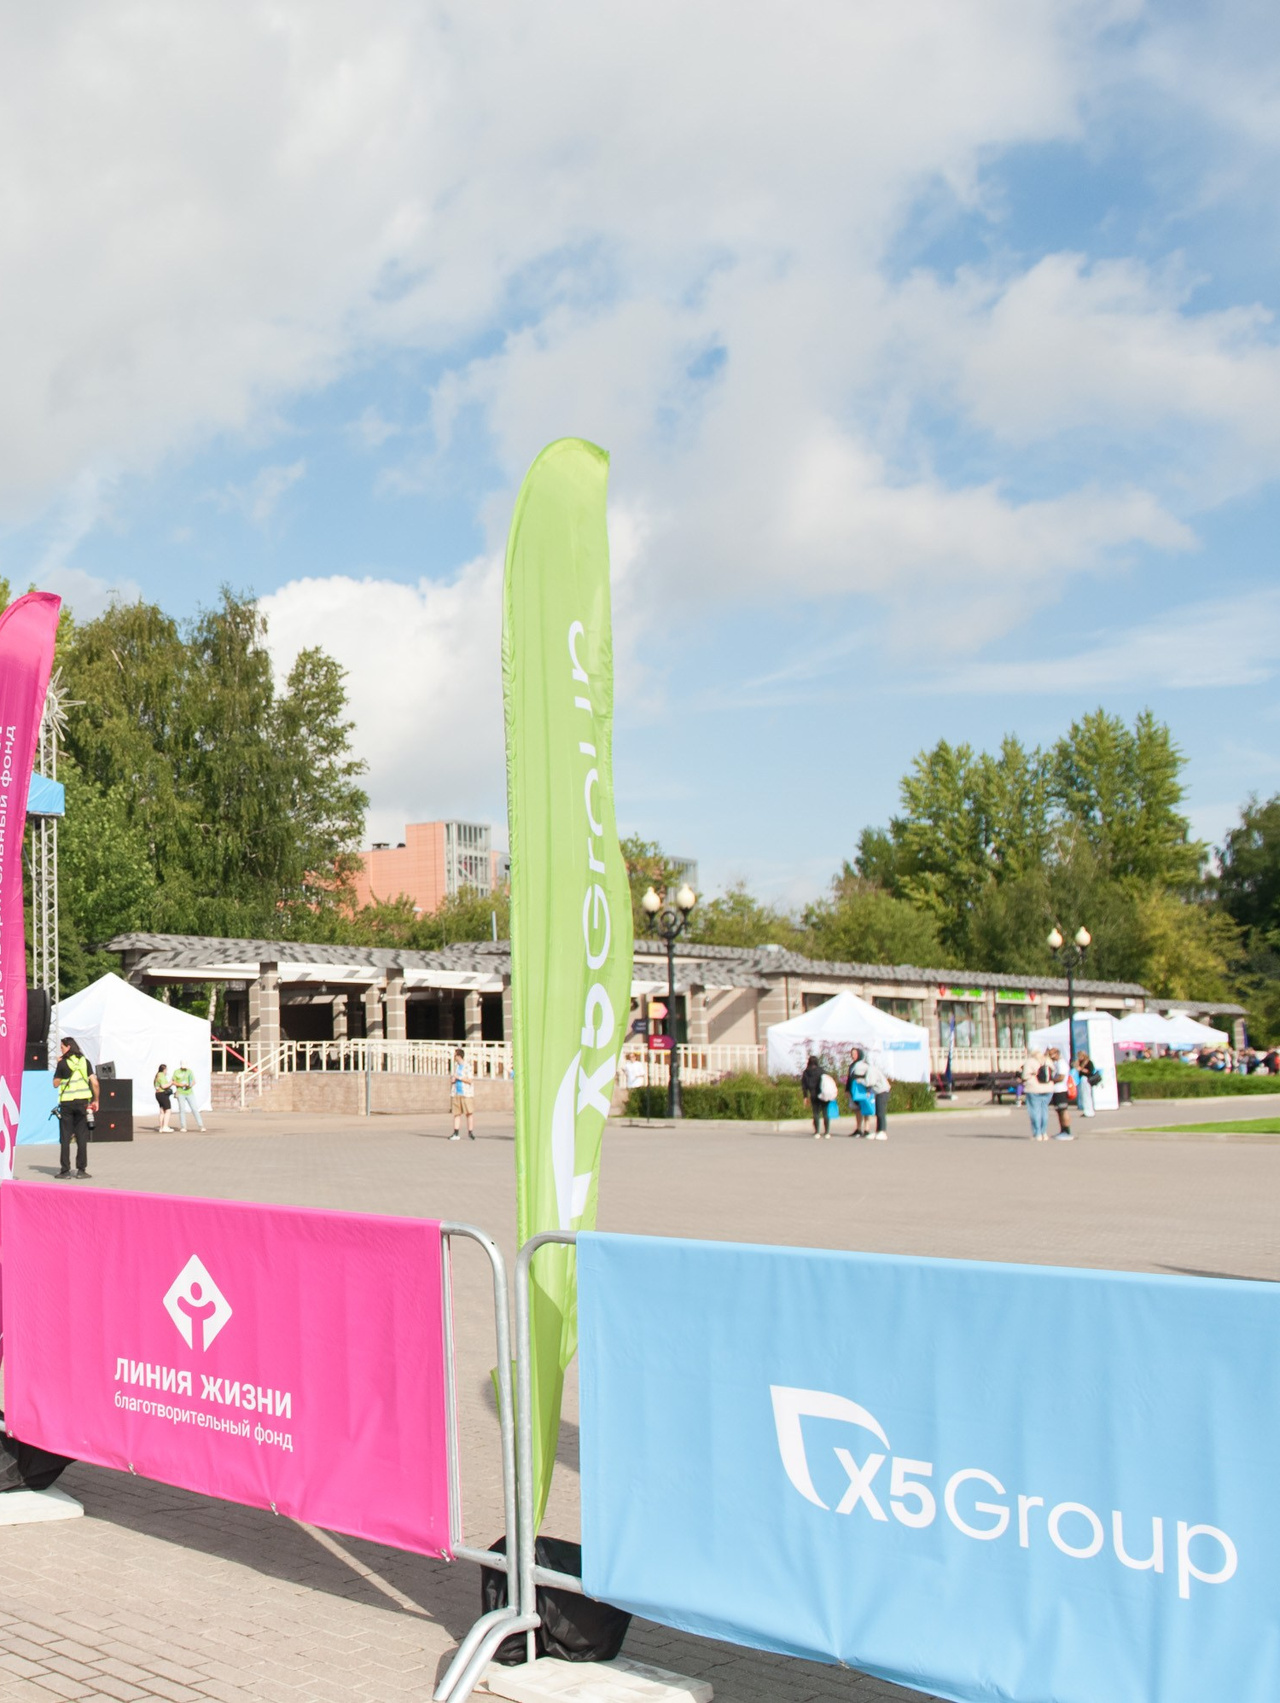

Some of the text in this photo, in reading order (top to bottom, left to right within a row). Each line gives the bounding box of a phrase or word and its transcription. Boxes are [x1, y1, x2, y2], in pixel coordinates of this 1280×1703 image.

[0, 725, 17, 788] фонд
[114, 1356, 292, 1419] ЛИНИЯ ЖИЗНИ
[114, 1390, 294, 1453] благотворительный фонд
[832, 1447, 1239, 1600] X5Group
